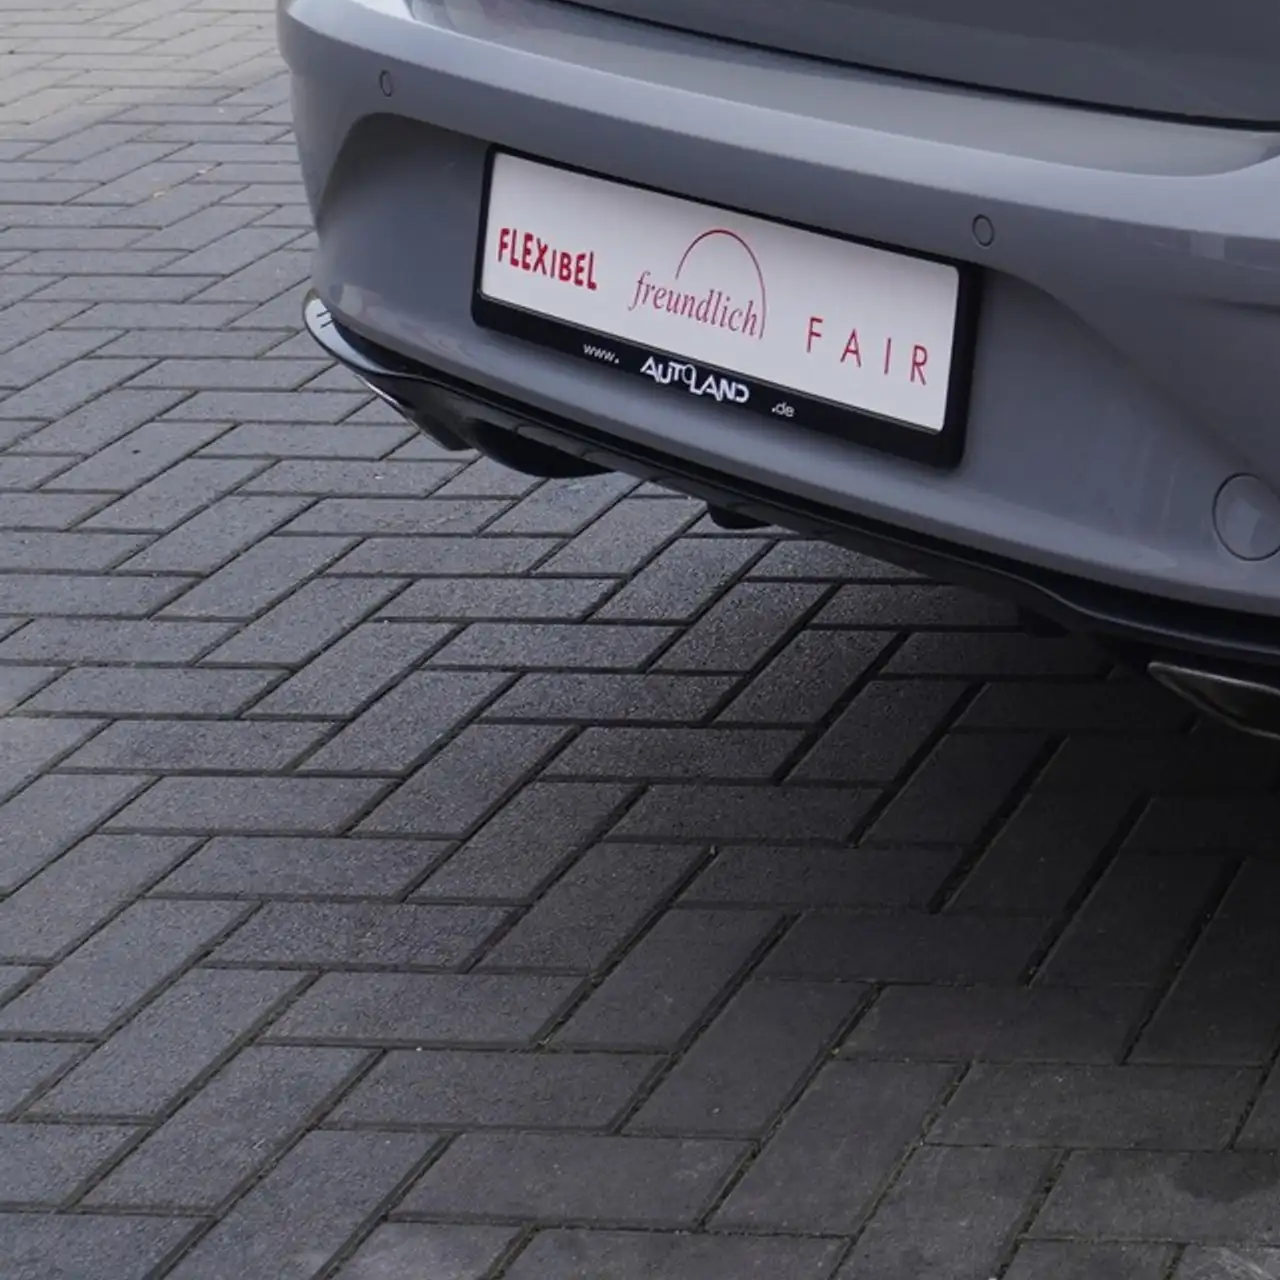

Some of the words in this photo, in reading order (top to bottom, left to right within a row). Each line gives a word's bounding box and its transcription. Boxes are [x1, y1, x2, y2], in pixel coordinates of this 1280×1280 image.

[497, 227, 598, 292] FLEXIBEL
[628, 270, 758, 336] freundlich
[582, 343, 621, 365] www.
[640, 355, 750, 404] AUTOLAND
[771, 401, 796, 418] .de
